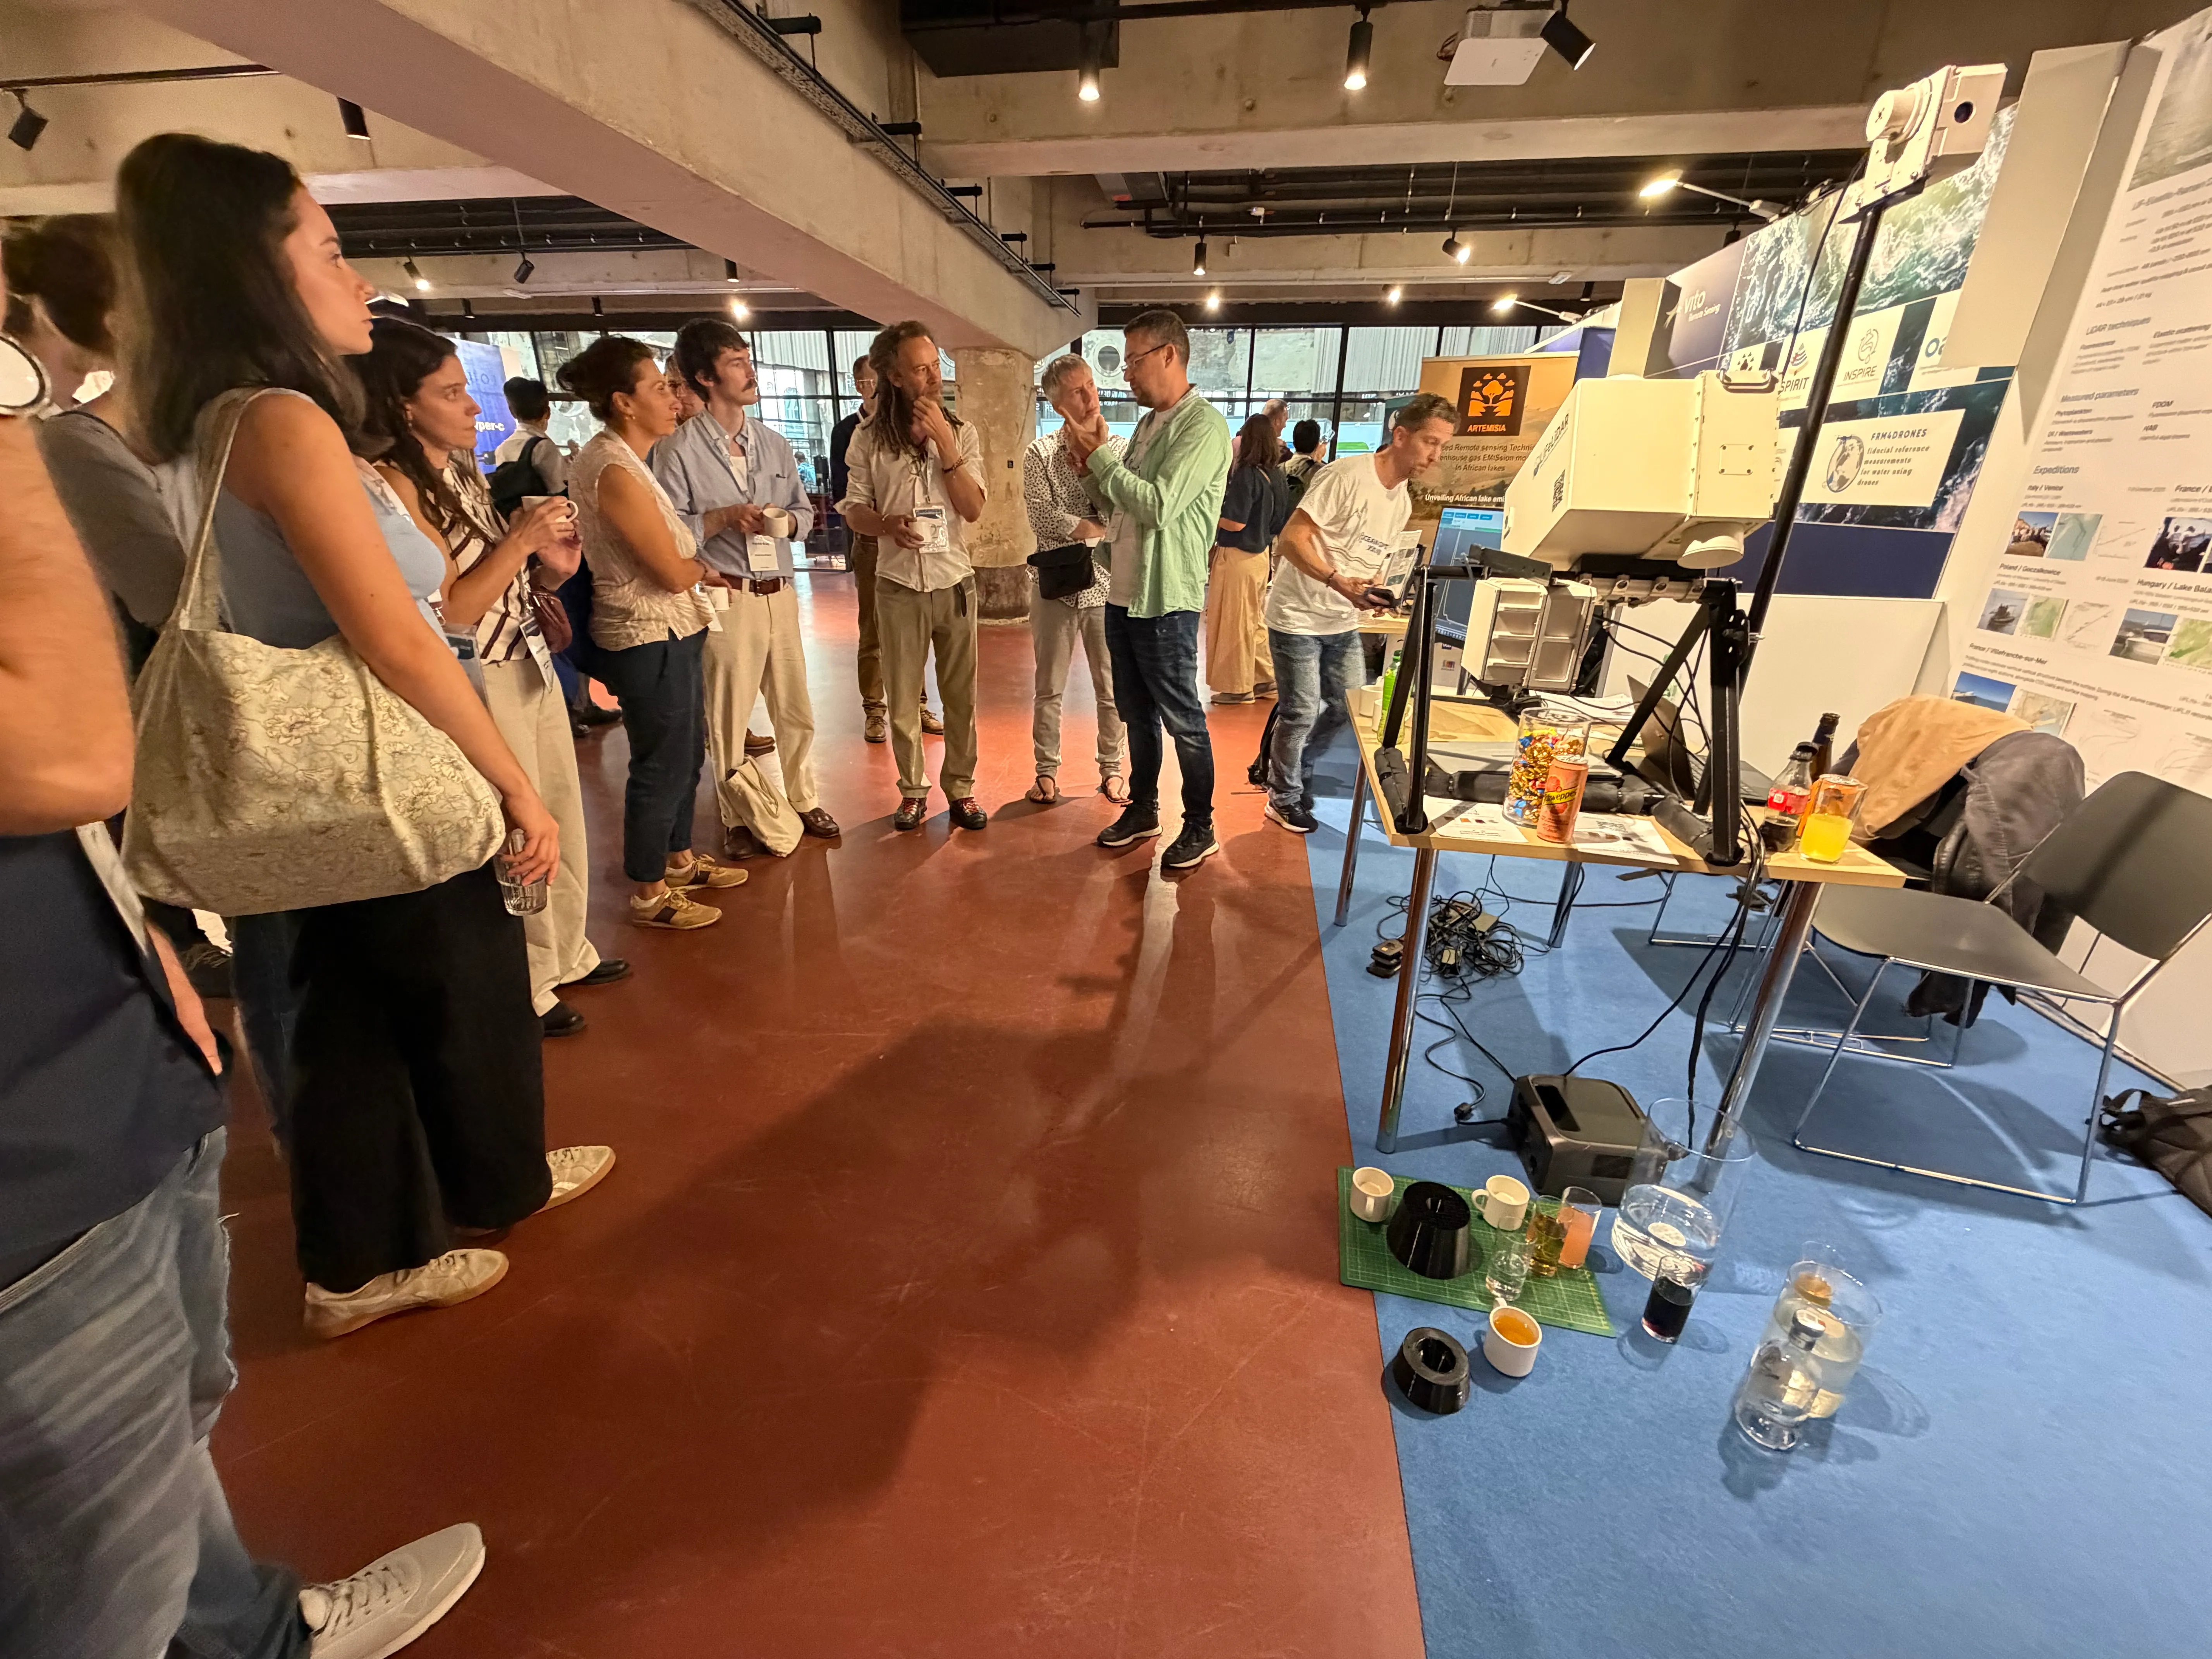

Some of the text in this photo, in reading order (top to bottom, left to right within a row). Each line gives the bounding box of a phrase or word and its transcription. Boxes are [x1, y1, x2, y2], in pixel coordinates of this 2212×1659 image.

[1843, 366, 1877, 381] INSPIRE
[1781, 377, 1810, 392] SPIRIT
[1467, 424, 1506, 433] ARTEMISIA
[1871, 429, 1927, 441] FRM4DRONES
[1480, 444, 1507, 452] sensing
[1867, 446, 1894, 454] fiducial
[1892, 467, 1913, 476] using
[2033, 466, 2080, 475] Expeditions
[2175, 484, 2202, 493] France
[1425, 493, 1454, 502] Unveiling
[1455, 493, 1478, 502] African
[2137, 579, 2167, 589] Hungary
